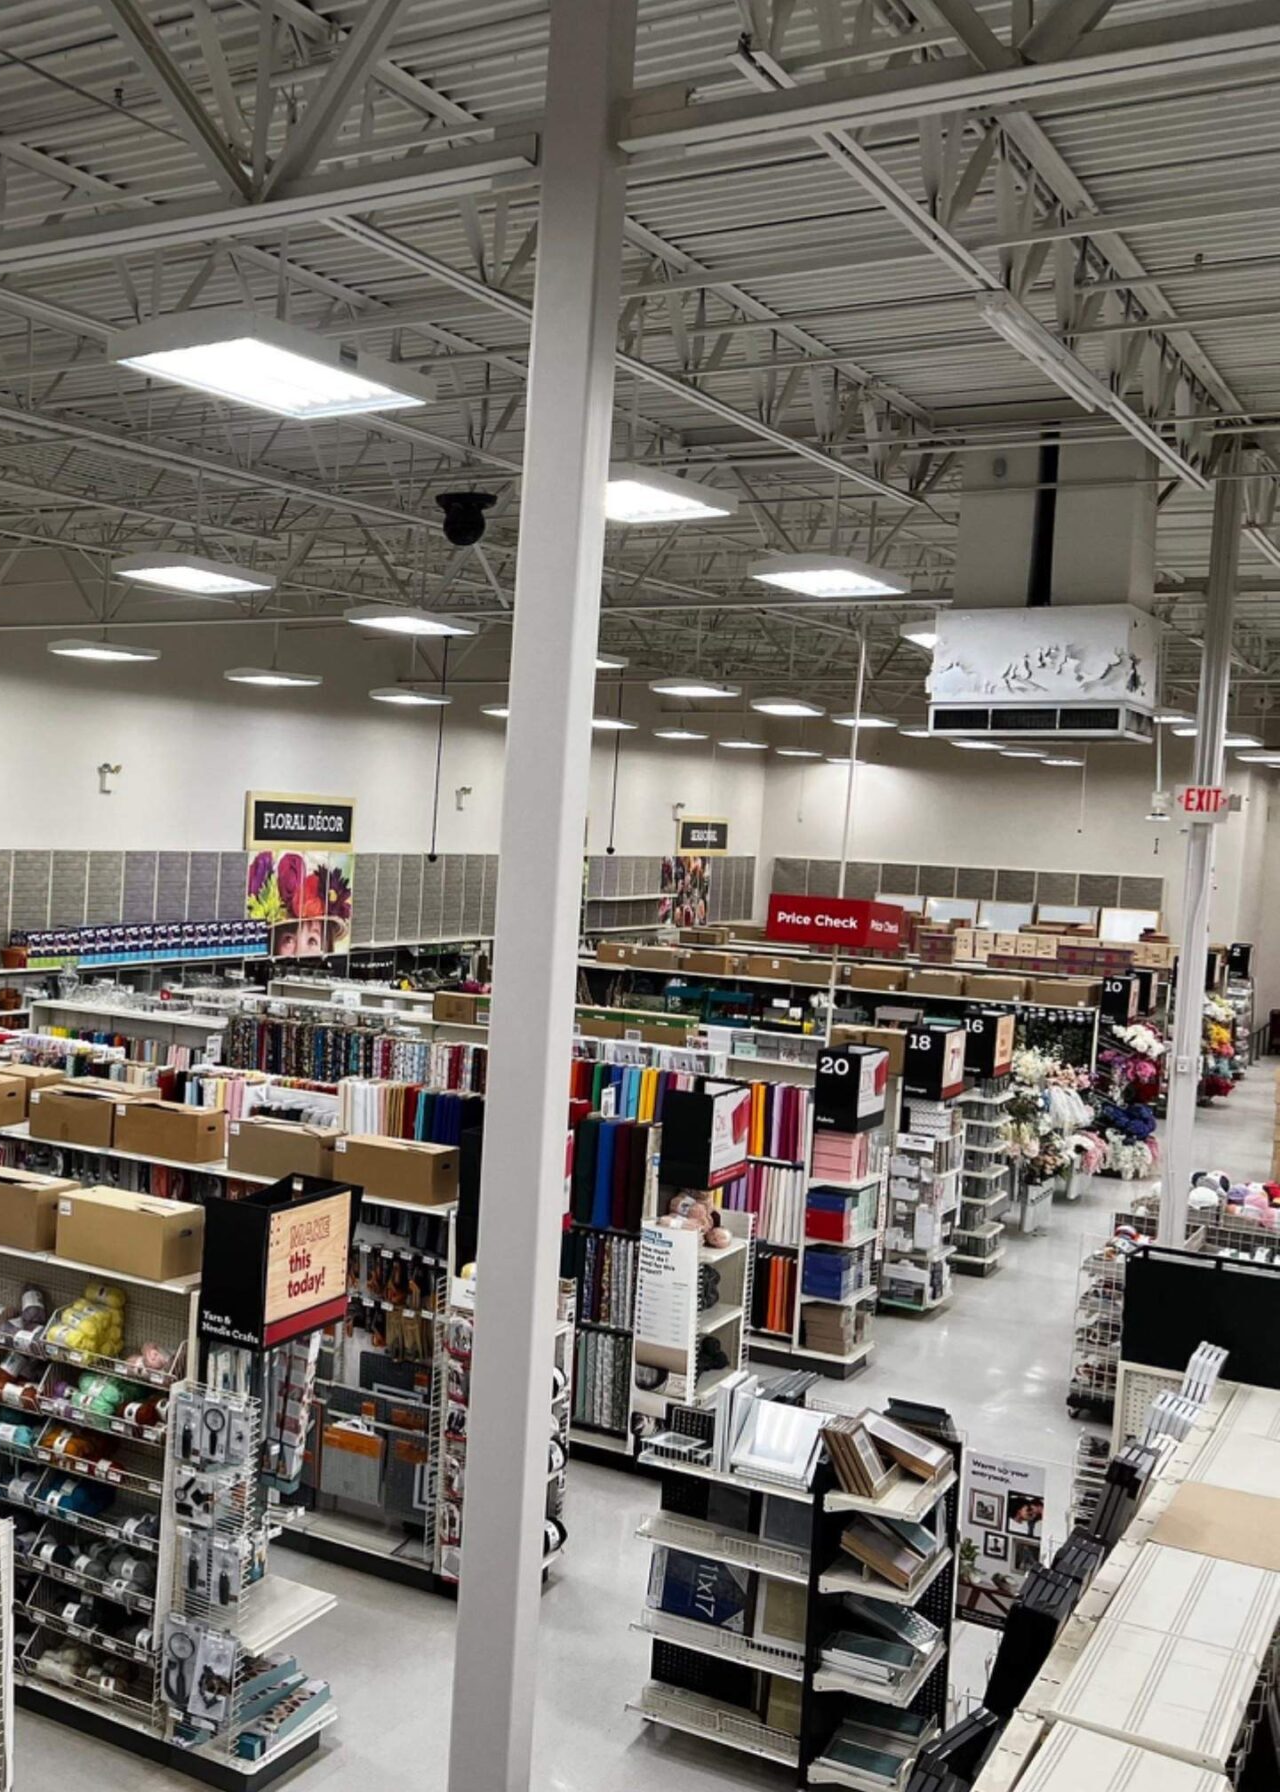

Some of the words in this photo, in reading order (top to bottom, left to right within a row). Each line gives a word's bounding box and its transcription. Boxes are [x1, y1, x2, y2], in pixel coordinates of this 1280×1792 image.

[1184, 788, 1222, 812] EXIT
[263, 812, 307, 831] FLORAL
[307, 809, 344, 832] DÉCOR
[776, 911, 812, 926] Price
[814, 914, 858, 930] Check
[1104, 980, 1123, 993] 10
[964, 1018, 984, 1034] 16
[909, 1034, 932, 1051] 18
[820, 1056, 850, 1076] 20
[289, 1214, 331, 1249] MAKE
[289, 1249, 312, 1275] this
[287, 1266, 326, 1298] today!
[202, 1310, 223, 1323] Yarn
[201, 1321, 231, 1337] Needle
[231, 1328, 259, 1345] Crafts
[972, 1459, 997, 1471] Warm
[694, 1563, 720, 1618] 11x17
